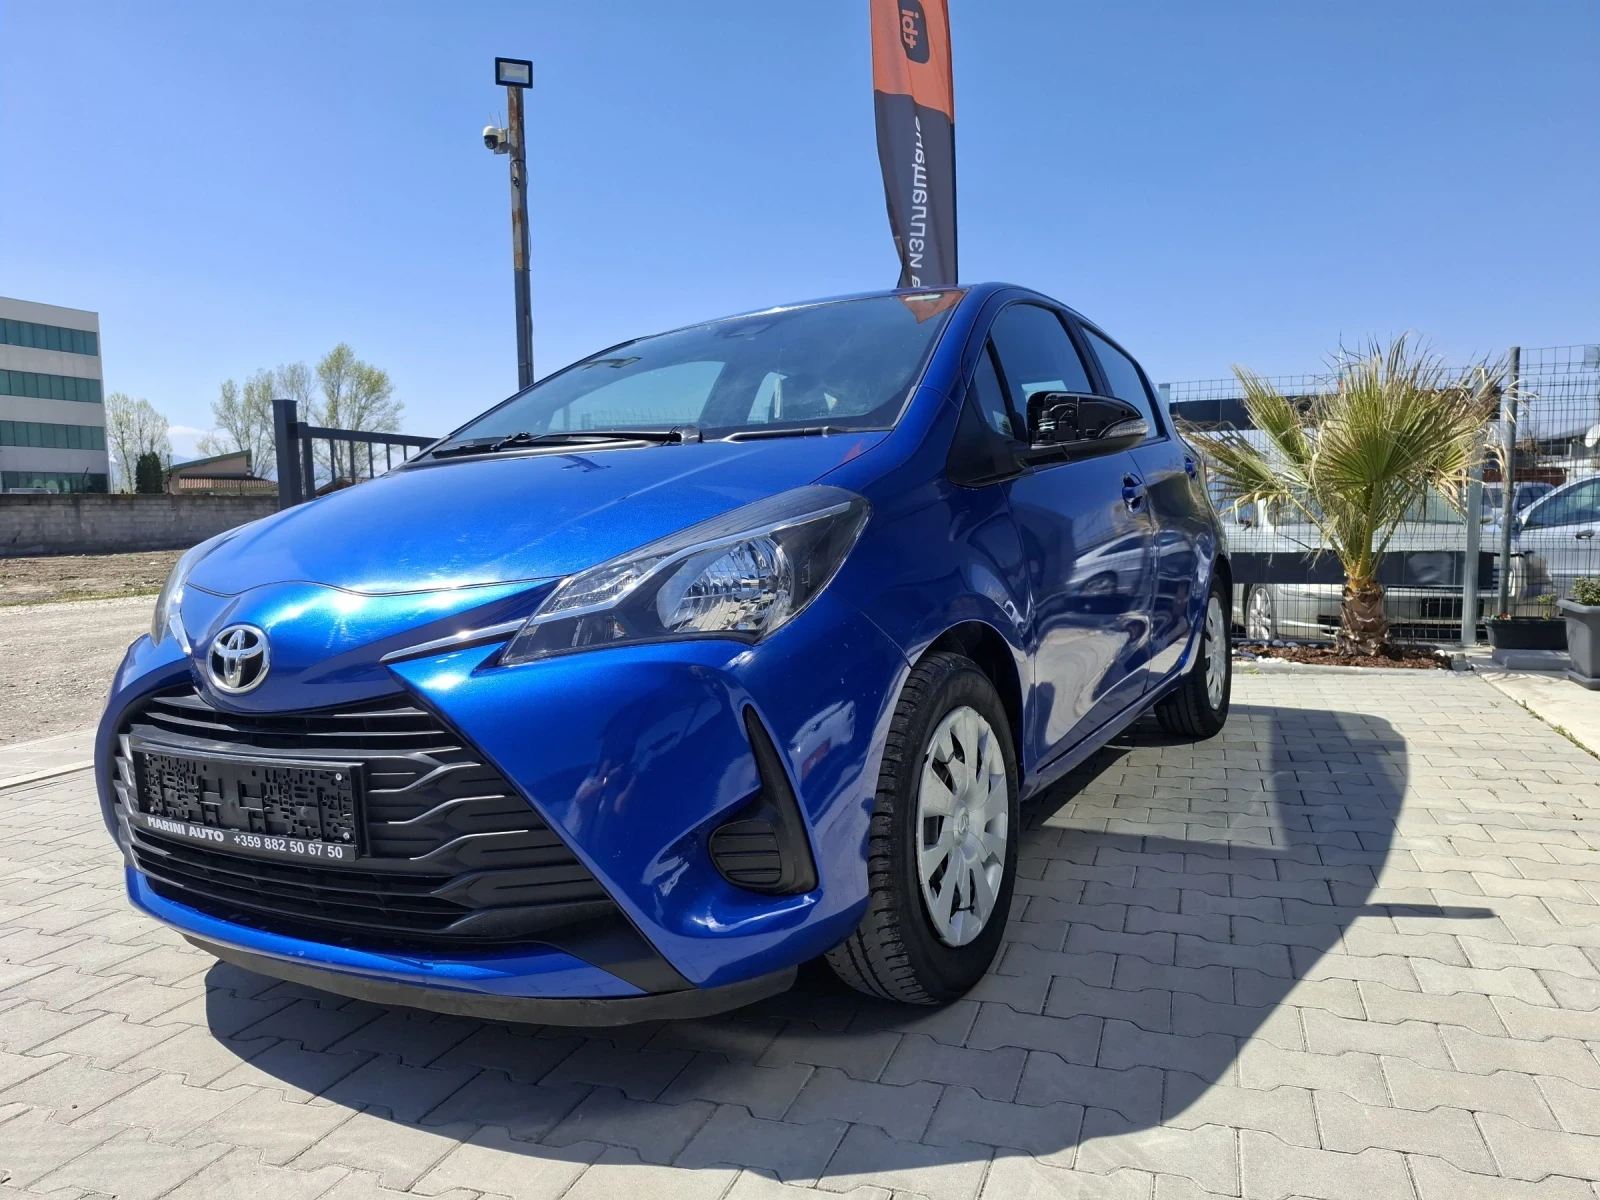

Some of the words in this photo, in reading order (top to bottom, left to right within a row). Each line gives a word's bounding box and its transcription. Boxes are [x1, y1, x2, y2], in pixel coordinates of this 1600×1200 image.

[147, 816, 185, 835] MARINI
[188, 827, 224, 842] AUTO
[233, 835, 261, 848] +359
[264, 839, 286, 851] 882
[289, 841, 304, 854] 50
[307, 844, 322, 856] 67
[327, 846, 343, 858] 50
